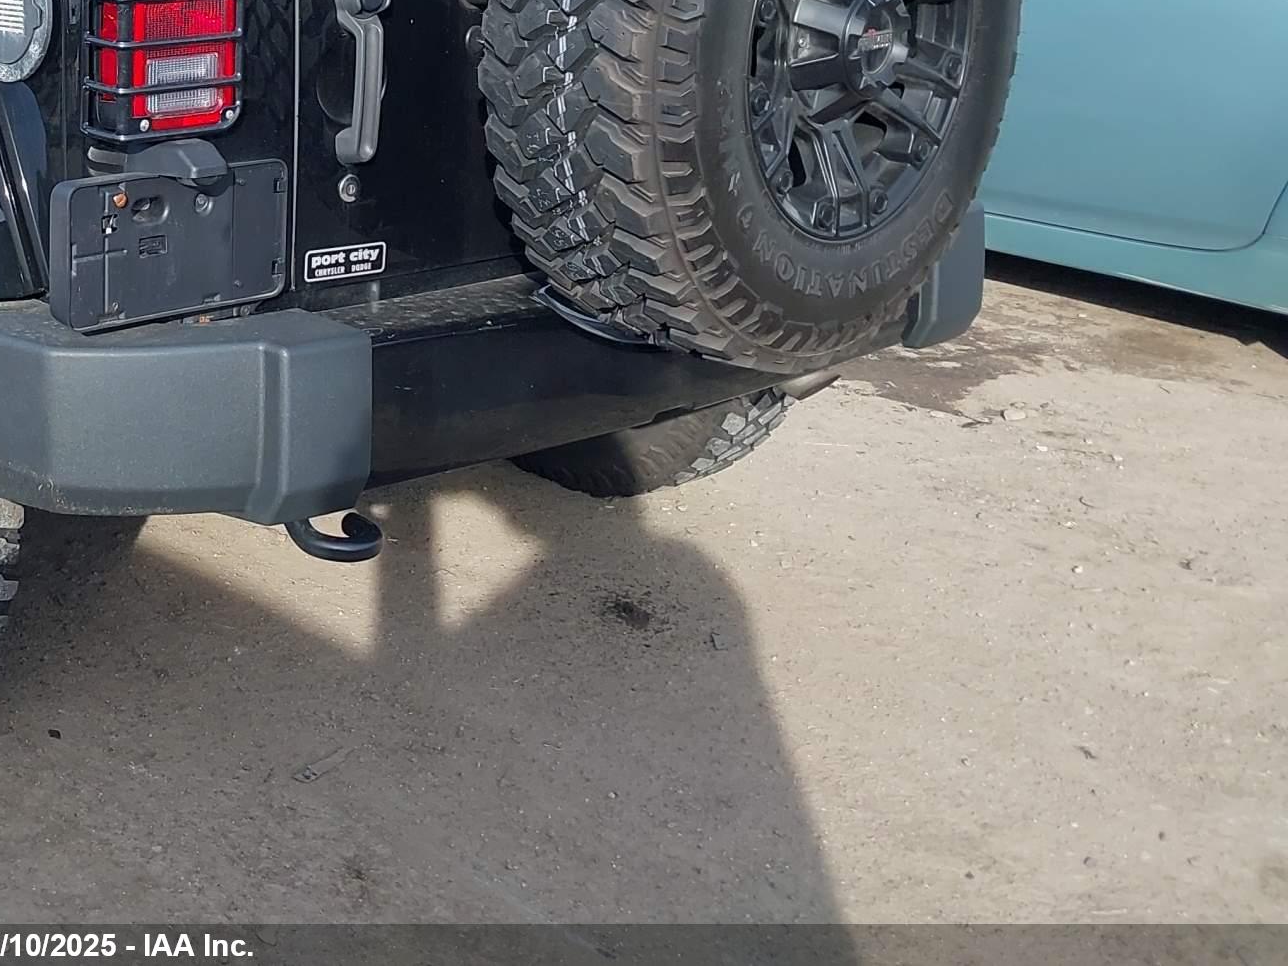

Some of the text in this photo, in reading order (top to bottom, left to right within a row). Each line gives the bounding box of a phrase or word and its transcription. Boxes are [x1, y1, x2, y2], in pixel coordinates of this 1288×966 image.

[311, 248, 380, 269] port city
[751, 190, 956, 299] DESTINATION
